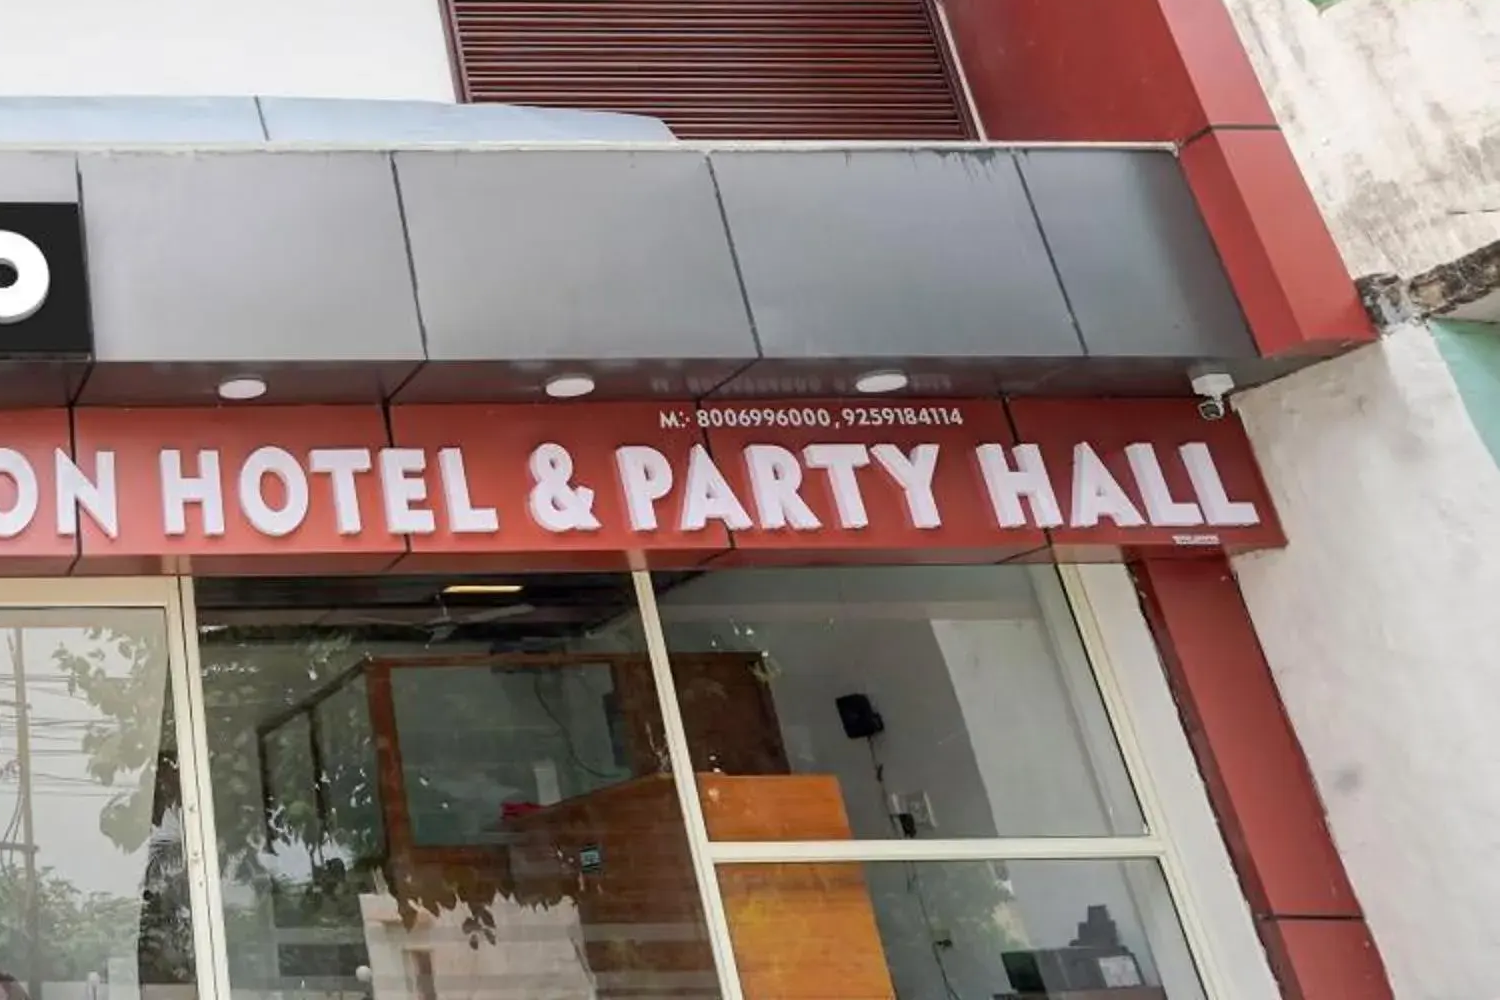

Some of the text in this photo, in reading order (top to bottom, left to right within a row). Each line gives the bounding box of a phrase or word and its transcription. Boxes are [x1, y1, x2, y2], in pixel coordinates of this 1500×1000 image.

[160, 446, 498, 537] HOTEL
[529, 443, 602, 532] &
[615, 442, 942, 531] PARTY
[975, 440, 1259, 530] HALL
